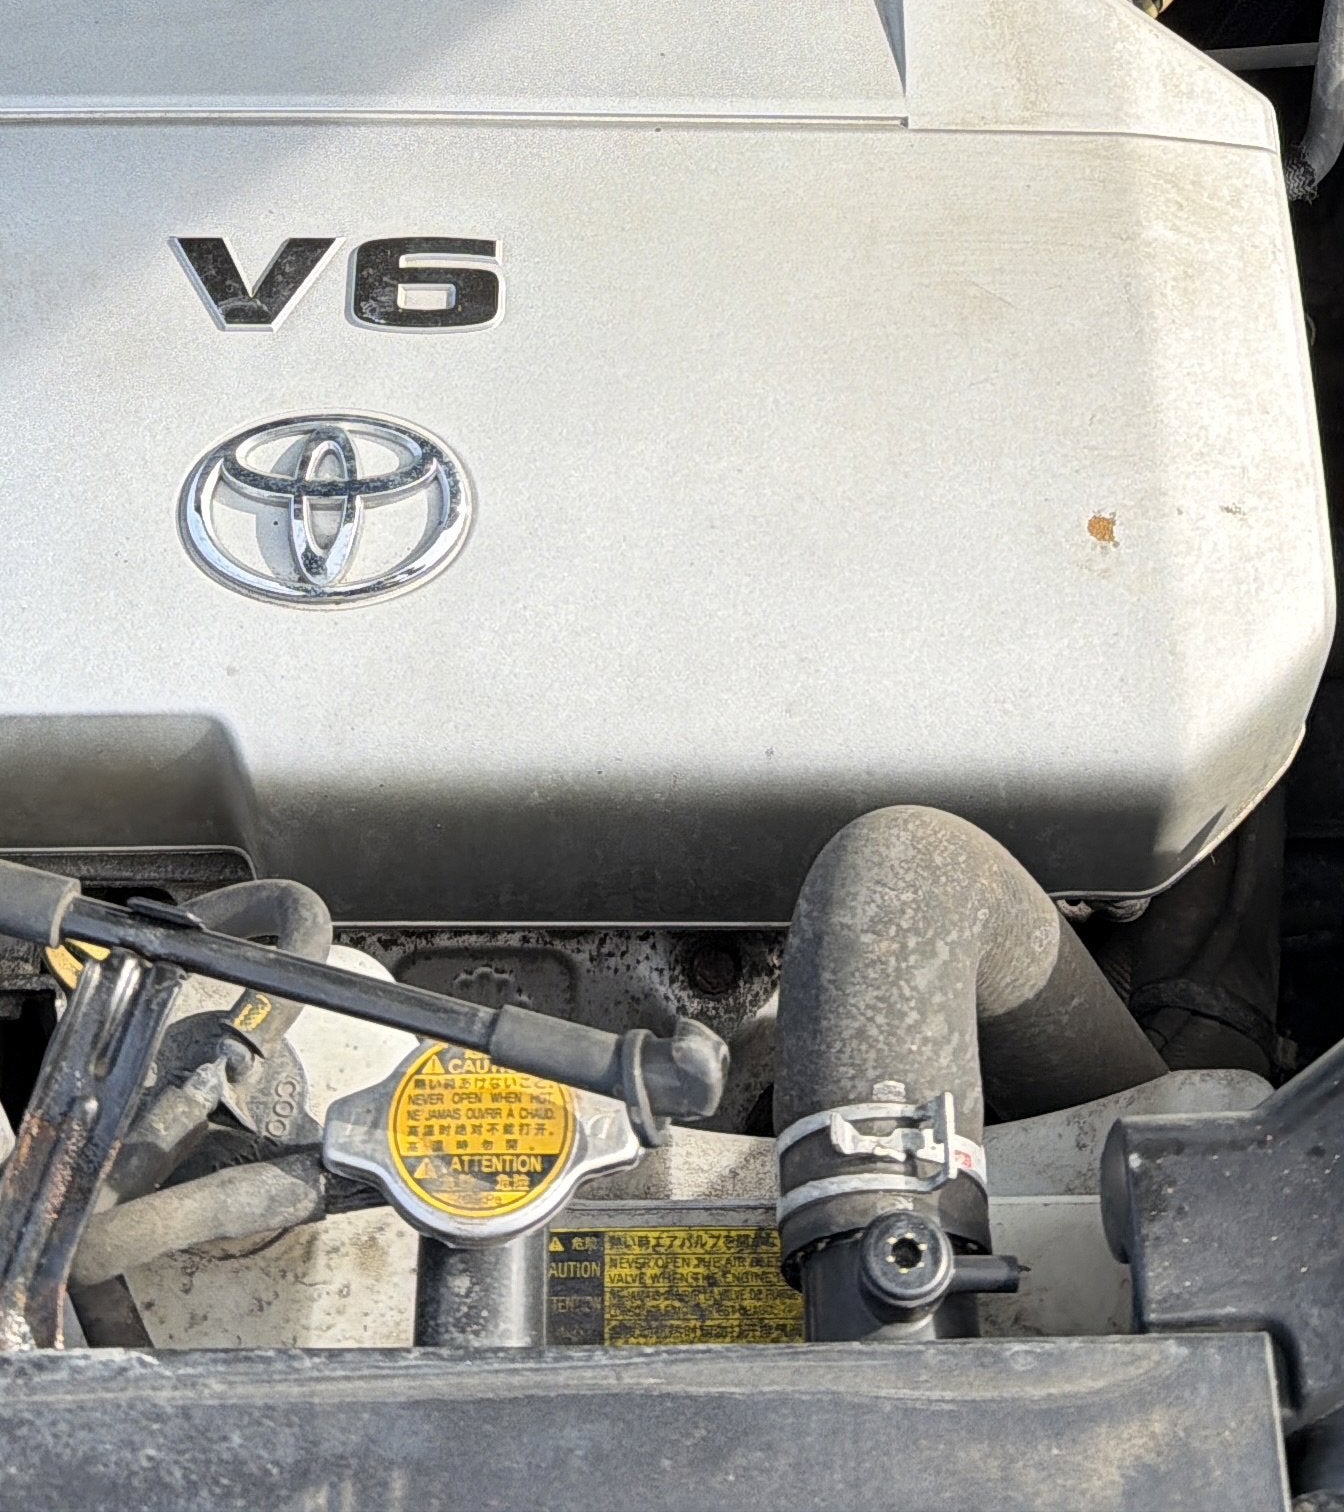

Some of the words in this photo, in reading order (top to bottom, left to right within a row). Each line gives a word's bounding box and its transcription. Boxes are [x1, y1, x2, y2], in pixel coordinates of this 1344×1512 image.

[168, 236, 506, 333] V6
[408, 1093, 444, 1106] NEVER
[452, 1092, 481, 1104] OPEN
[491, 1092, 522, 1104] WHEN
[407, 1109, 420, 1121] NE
[425, 1108, 461, 1120] JAMAIS
[451, 1156, 542, 1173] ATTENTION
[549, 1261, 601, 1279] AUTION
[655, 1257, 691, 1269] OPEN
[609, 1272, 646, 1285] VALVE
